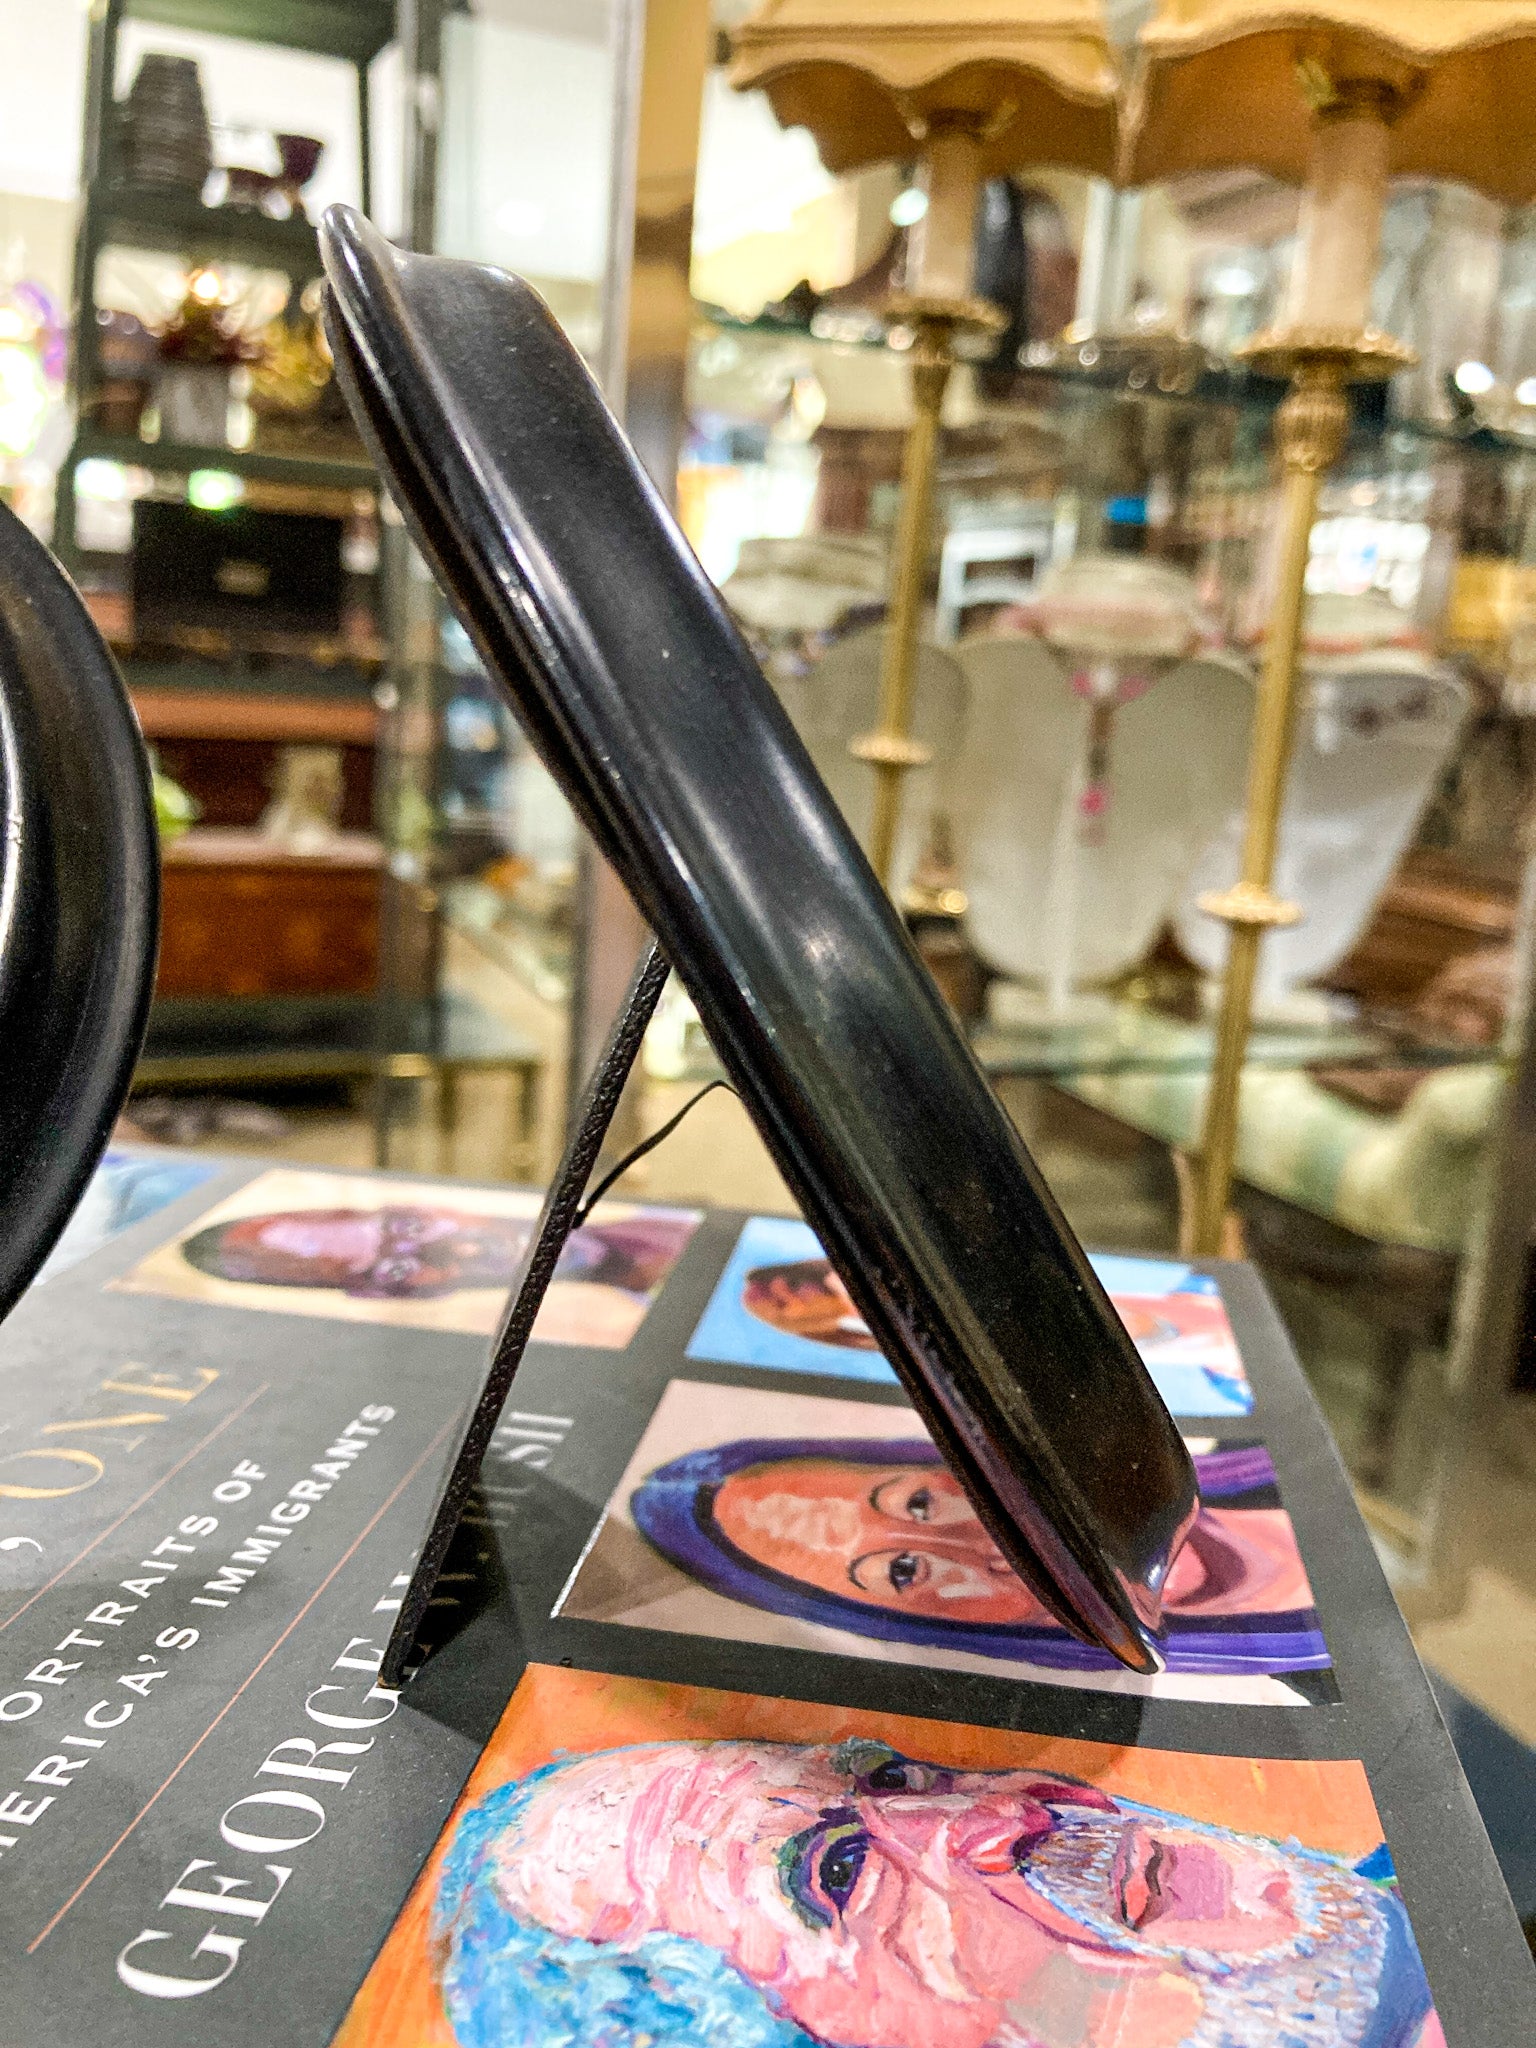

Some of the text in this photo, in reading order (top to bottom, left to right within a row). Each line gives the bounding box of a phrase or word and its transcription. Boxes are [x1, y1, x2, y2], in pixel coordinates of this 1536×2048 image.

[212, 1459, 267, 1503] OF
[0, 1403, 396, 1858] ERICA'S IMMIGRANTS
